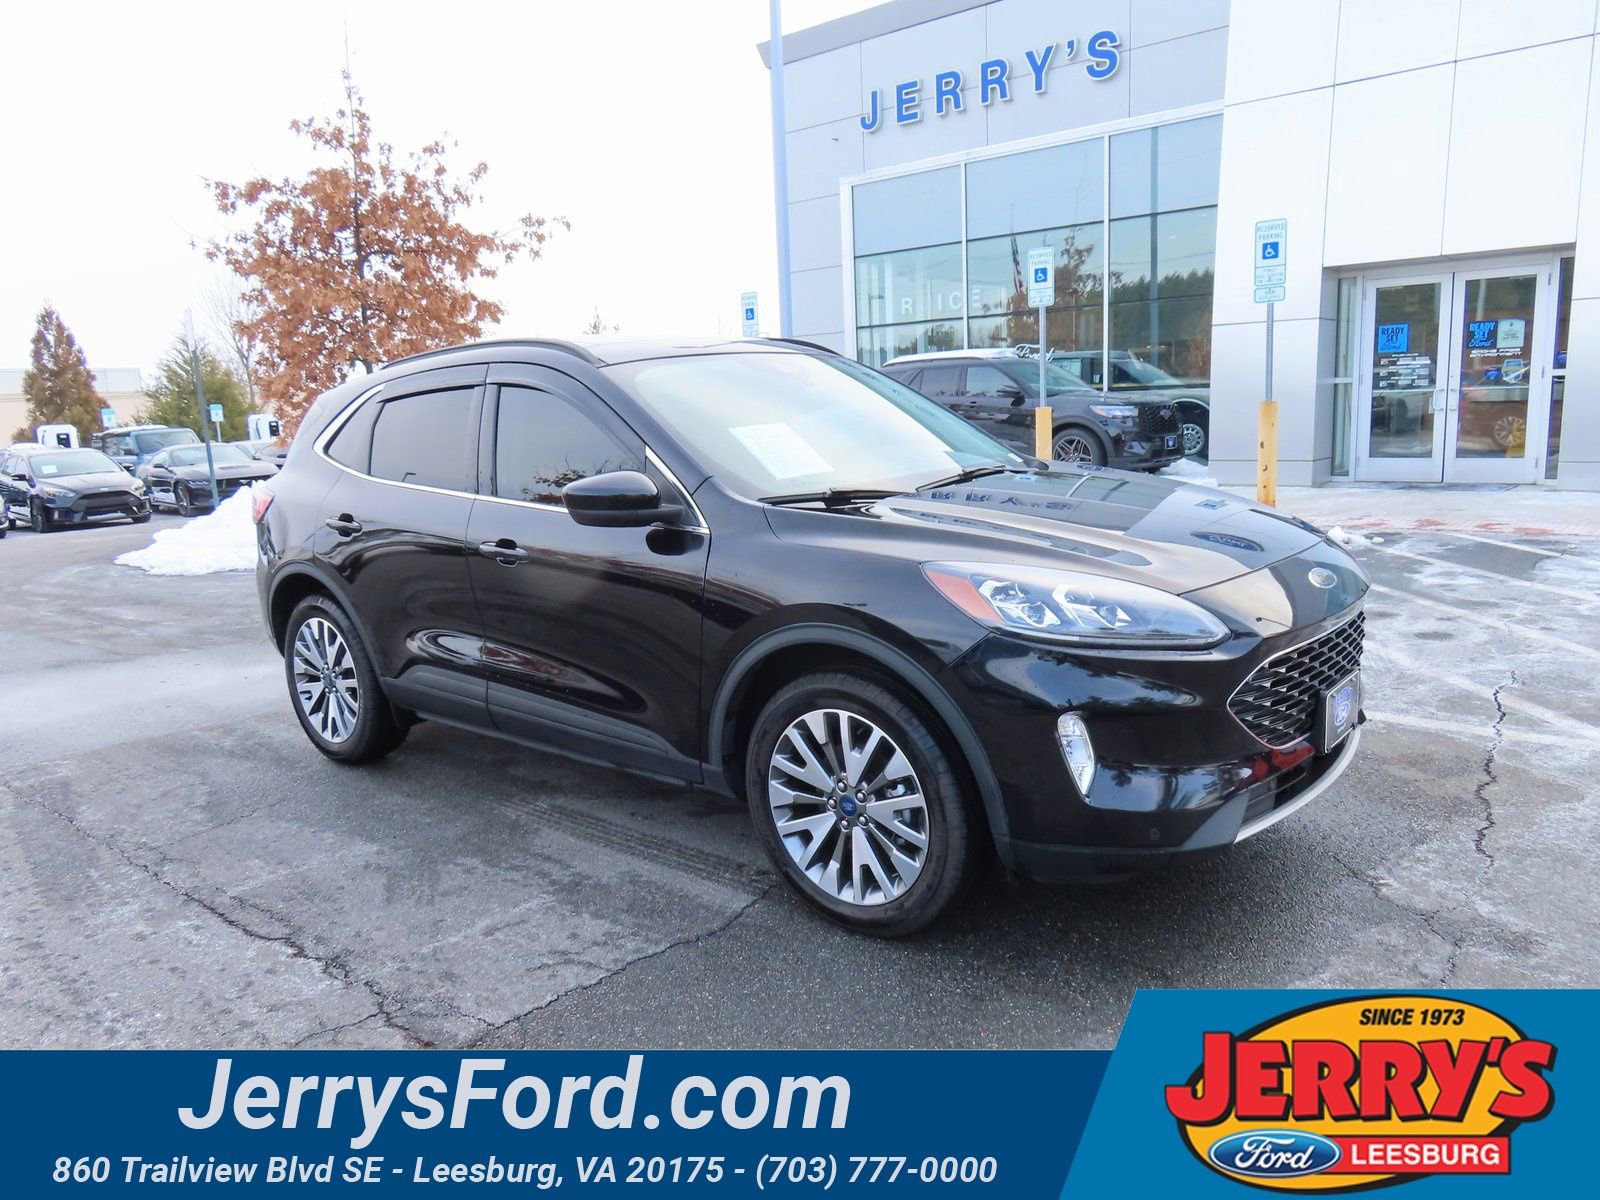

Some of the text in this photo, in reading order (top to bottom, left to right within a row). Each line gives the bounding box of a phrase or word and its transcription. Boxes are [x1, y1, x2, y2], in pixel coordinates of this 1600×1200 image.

[860, 30, 1120, 132] JERRY'S
[1381, 326, 1405, 335] READY
[1469, 321, 1496, 332] READY
[1386, 334, 1399, 342] SET
[1474, 330, 1488, 338] SET
[1468, 337, 1494, 347] Ford
